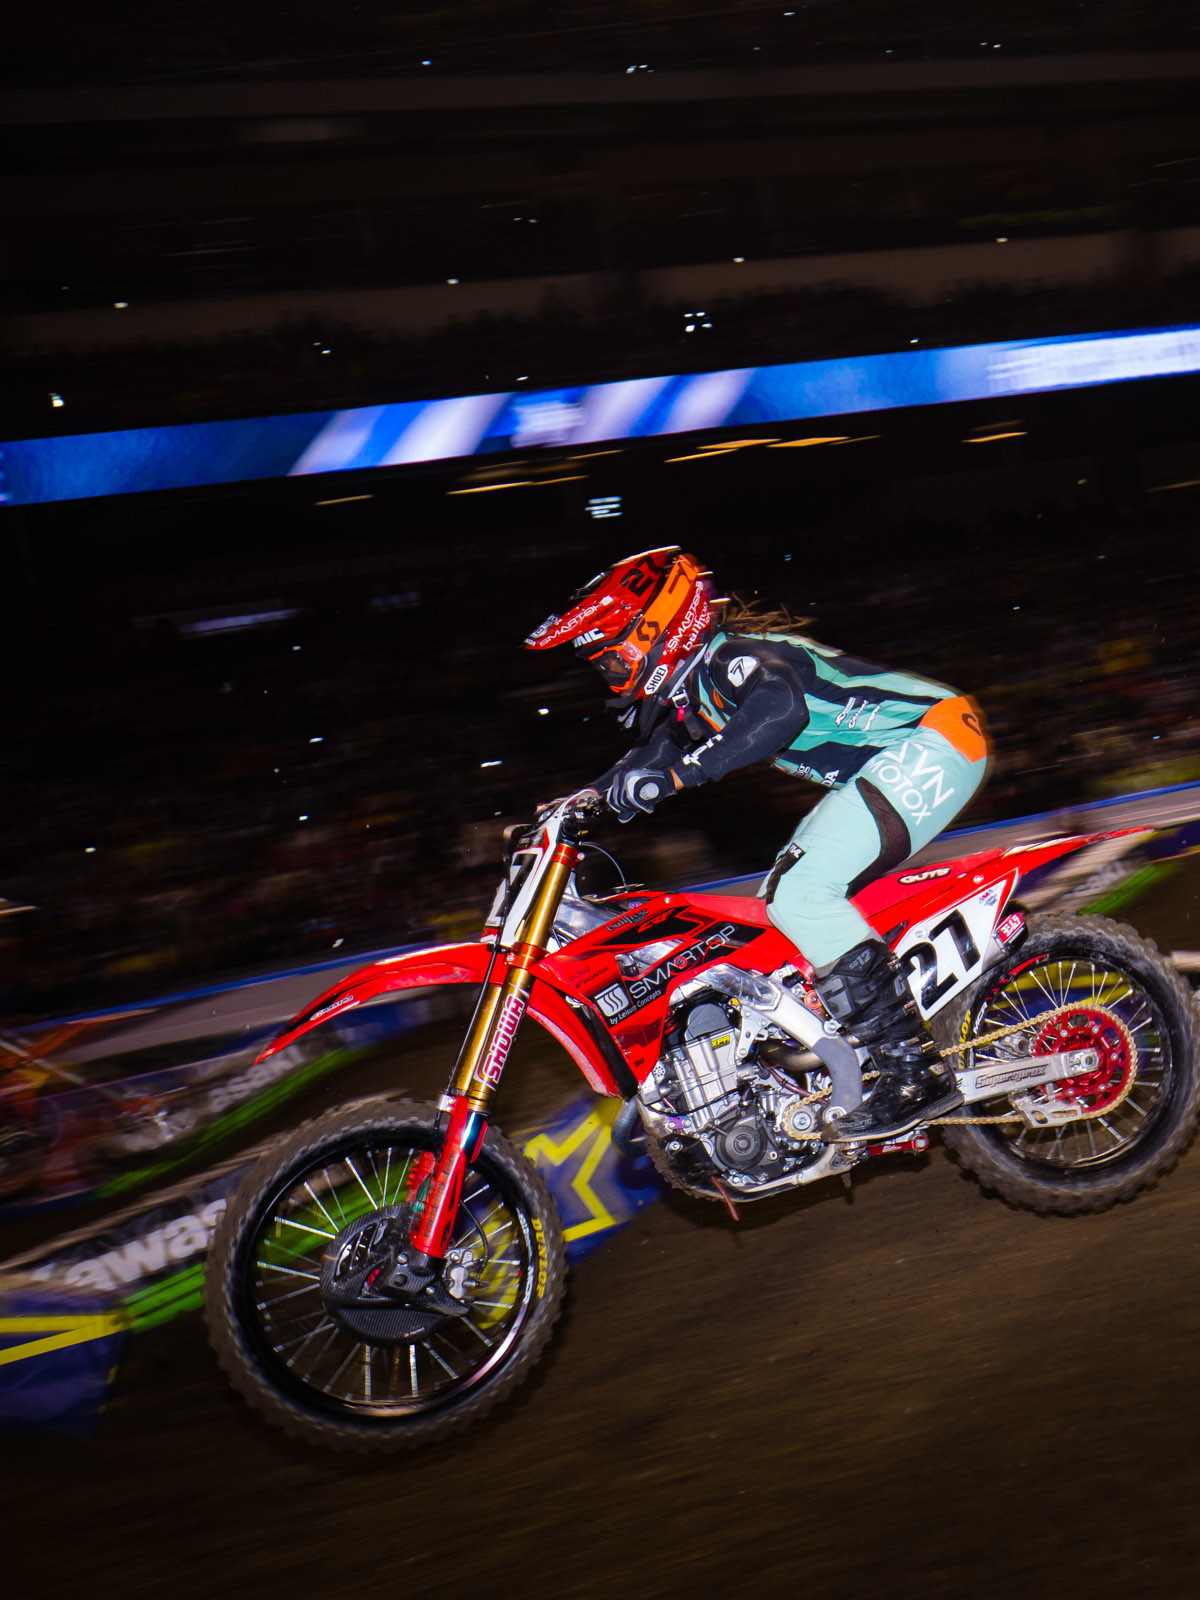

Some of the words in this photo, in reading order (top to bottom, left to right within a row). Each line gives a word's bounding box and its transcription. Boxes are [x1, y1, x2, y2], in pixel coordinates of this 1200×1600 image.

[647, 667, 665, 692] SHOEI
[865, 757, 932, 825] MOTOX
[900, 868, 950, 884] GUTS
[629, 925, 736, 999] SMARTOP
[907, 909, 981, 1011] 27
[487, 995, 524, 1083] SHOWA
[609, 1016, 618, 1025] by
[636, 989, 662, 1011] Concepts
[30, 1198, 228, 1291] awas
[531, 1218, 548, 1298] DUNLOP
